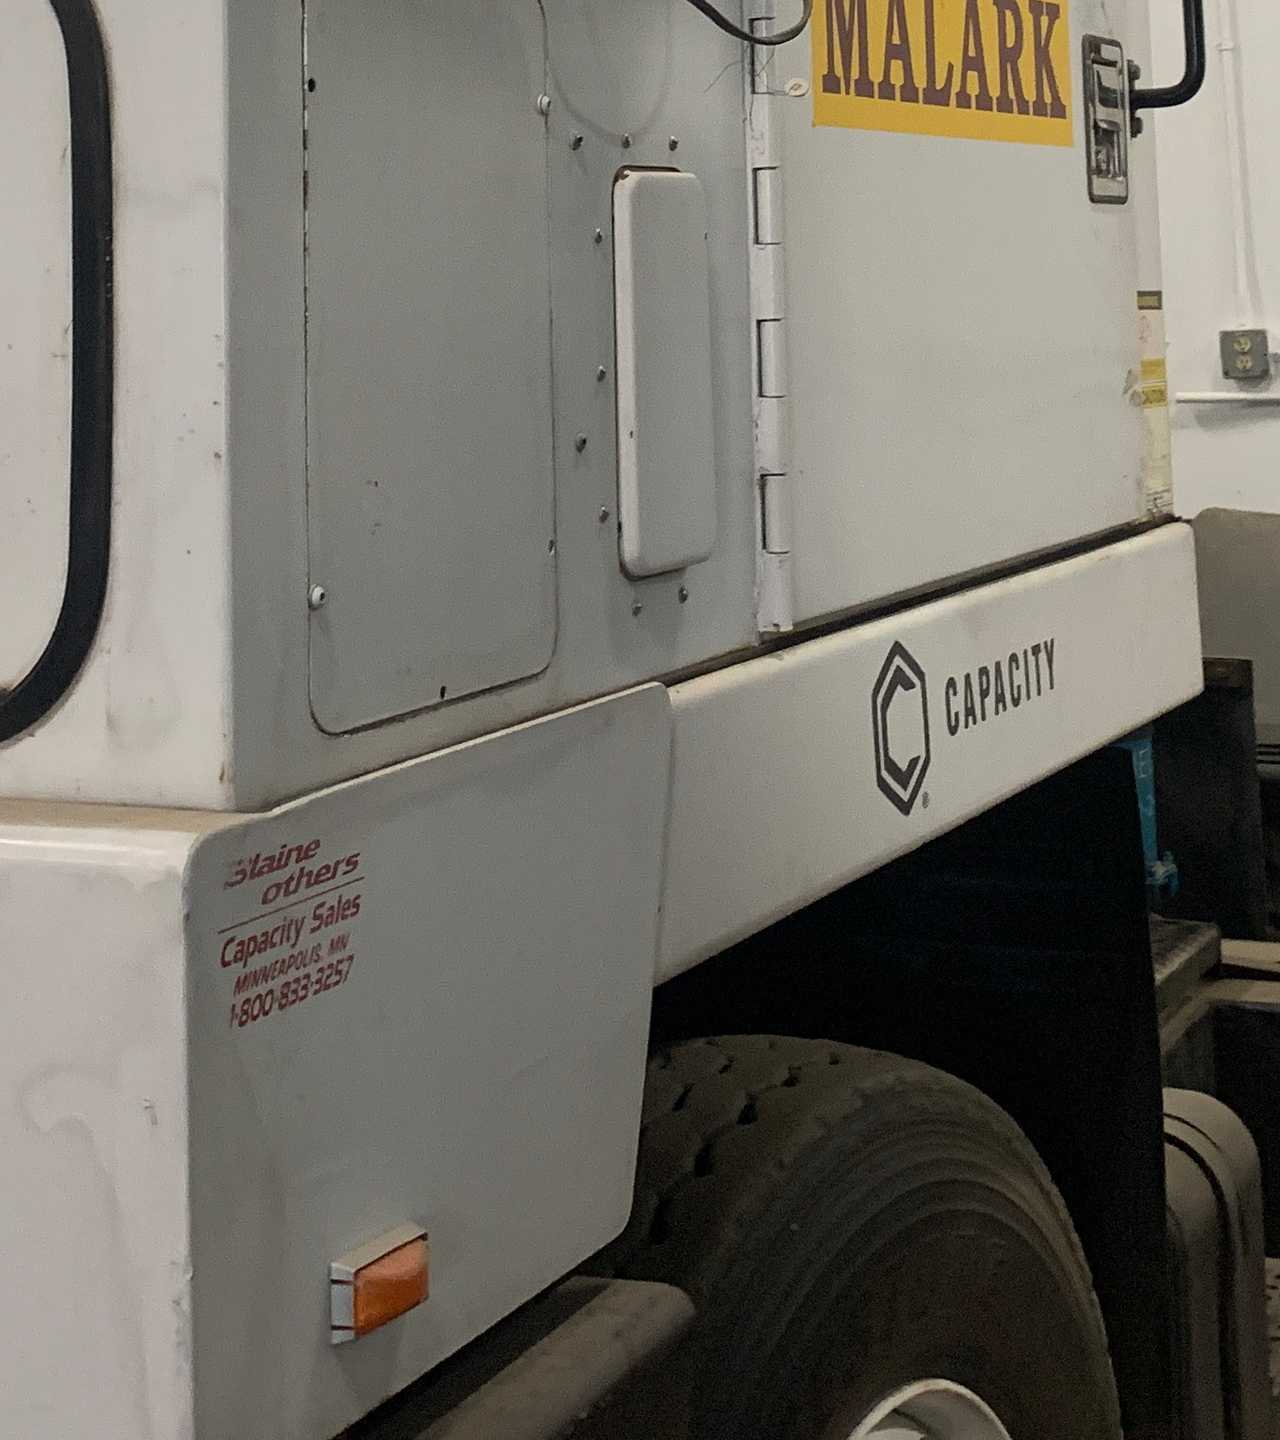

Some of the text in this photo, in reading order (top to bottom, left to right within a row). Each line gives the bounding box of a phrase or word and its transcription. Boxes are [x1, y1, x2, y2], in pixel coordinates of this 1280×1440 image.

[945, 638, 1055, 737] CAPACITY
[220, 894, 361, 968] Capacity Sales
[327, 933, 350, 954] MN
